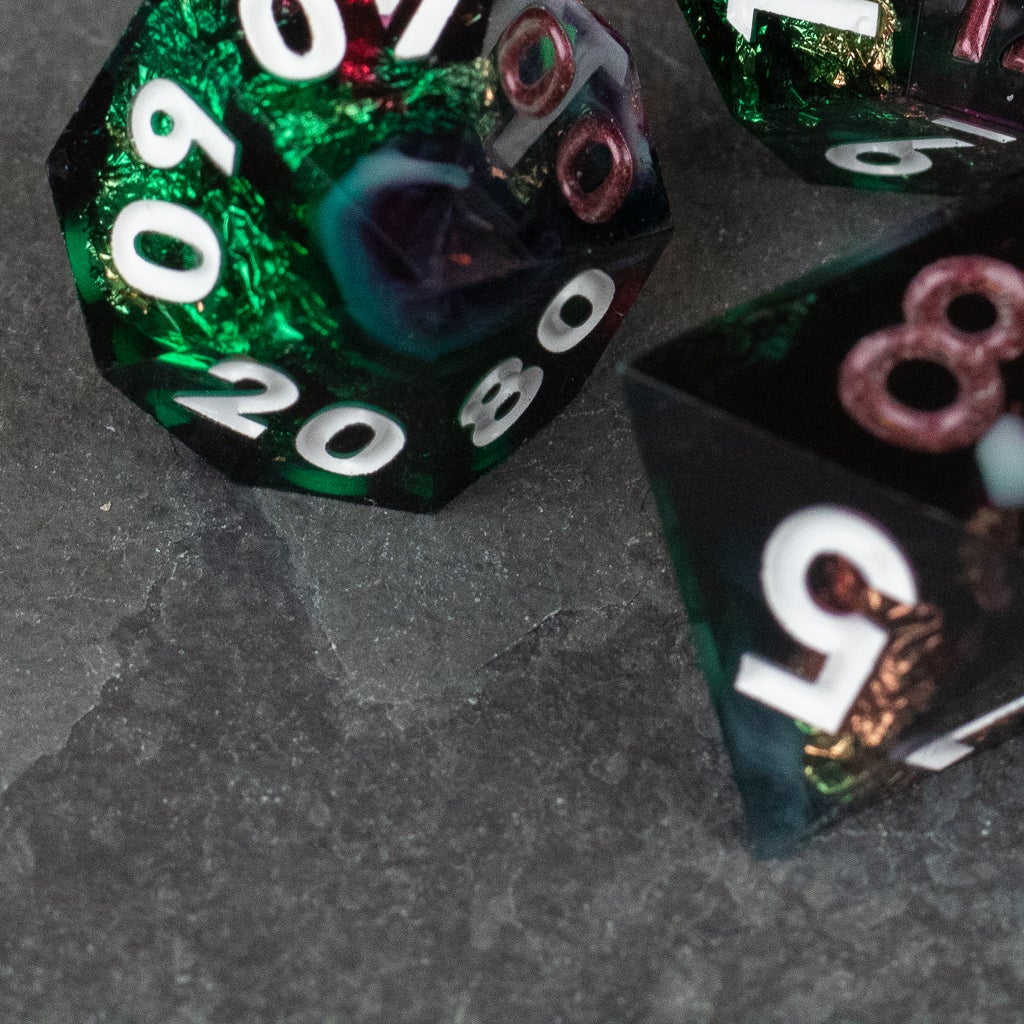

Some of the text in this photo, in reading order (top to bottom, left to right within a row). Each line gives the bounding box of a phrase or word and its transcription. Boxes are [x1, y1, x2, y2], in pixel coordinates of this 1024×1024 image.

[499, 4, 635, 225] 00
[172, 358, 408, 477] 20
[457, 267, 618, 448] 80
[732, 502, 919, 735] 5
